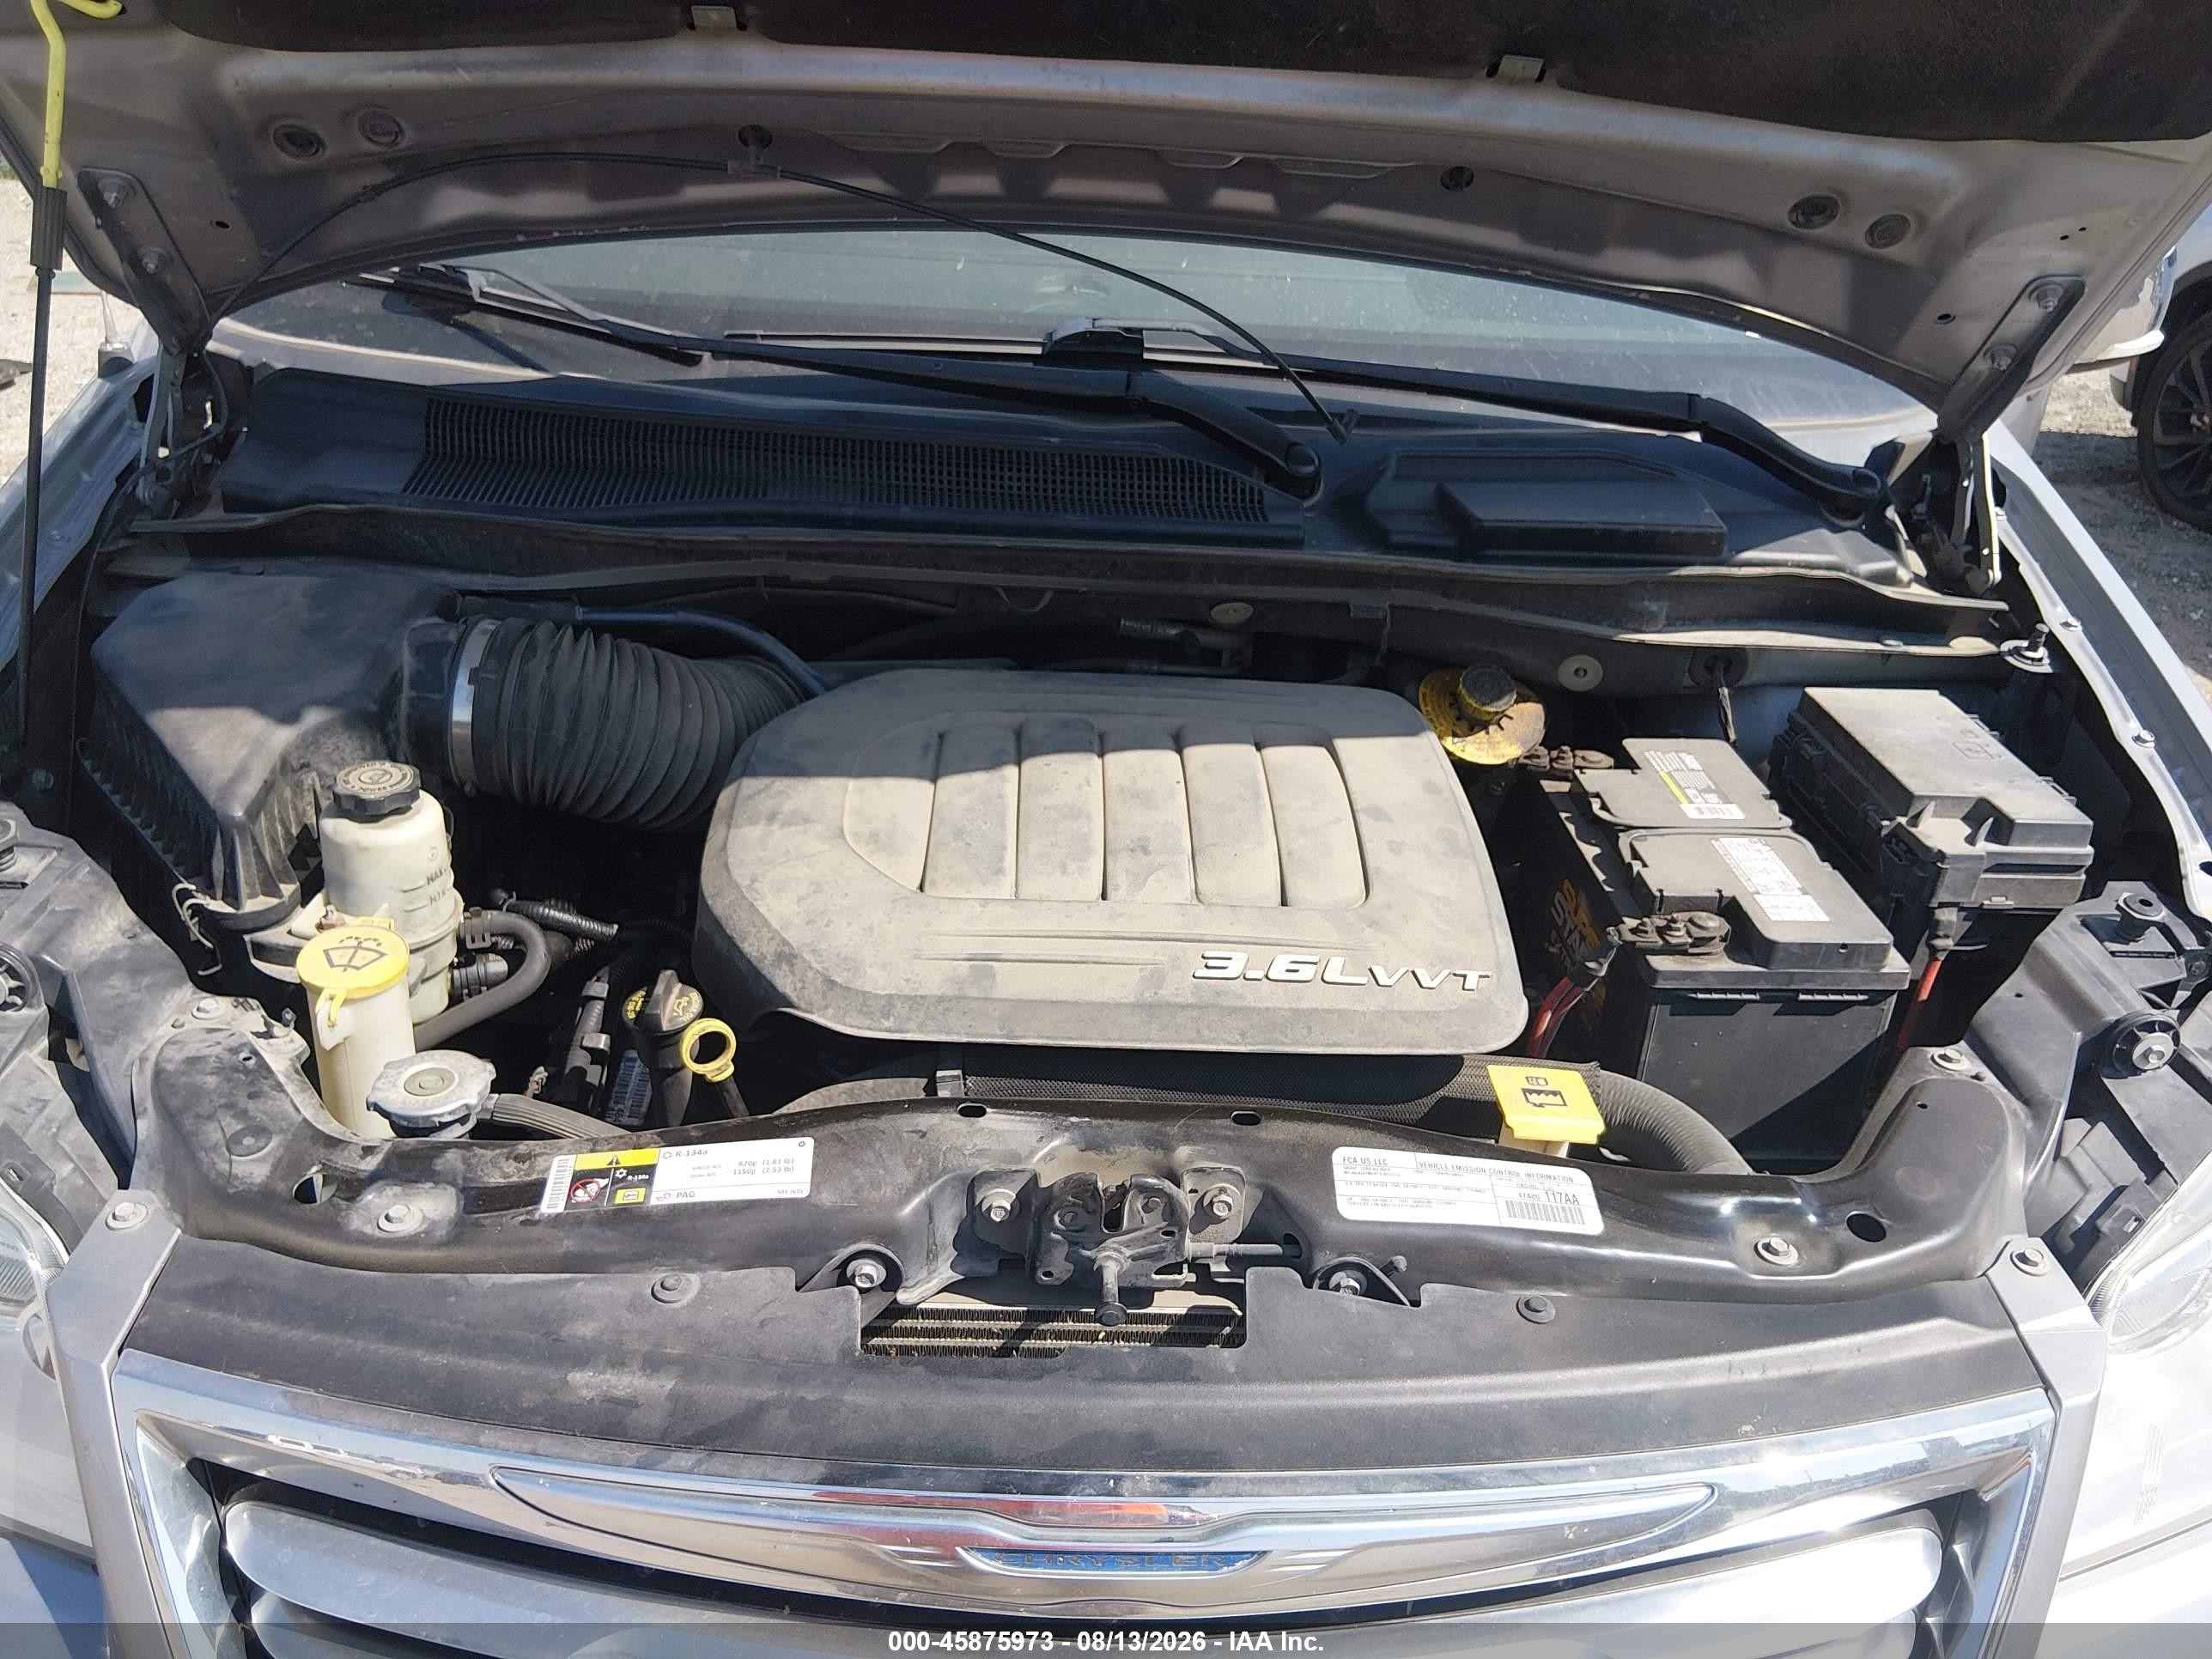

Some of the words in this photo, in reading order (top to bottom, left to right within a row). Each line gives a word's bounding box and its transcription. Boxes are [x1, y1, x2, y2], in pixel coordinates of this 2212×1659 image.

[676, 1149, 708, 1158] R-134a
[1342, 1156, 1358, 1164] FCA
[1360, 1157, 1371, 1165] US
[1373, 1158, 1389, 1166] LLC
[1418, 1161, 1448, 1170] VEHICLE
[1451, 1164, 1486, 1175] EMISSION
[1488, 1168, 1521, 1177] CONTROL
[1524, 1170, 1574, 1183] INFORMATION
[676, 1190, 696, 1199] PAG
[1545, 1191, 1581, 1206] 117AA
[994, 1550, 1228, 1570] CHRYSLER
